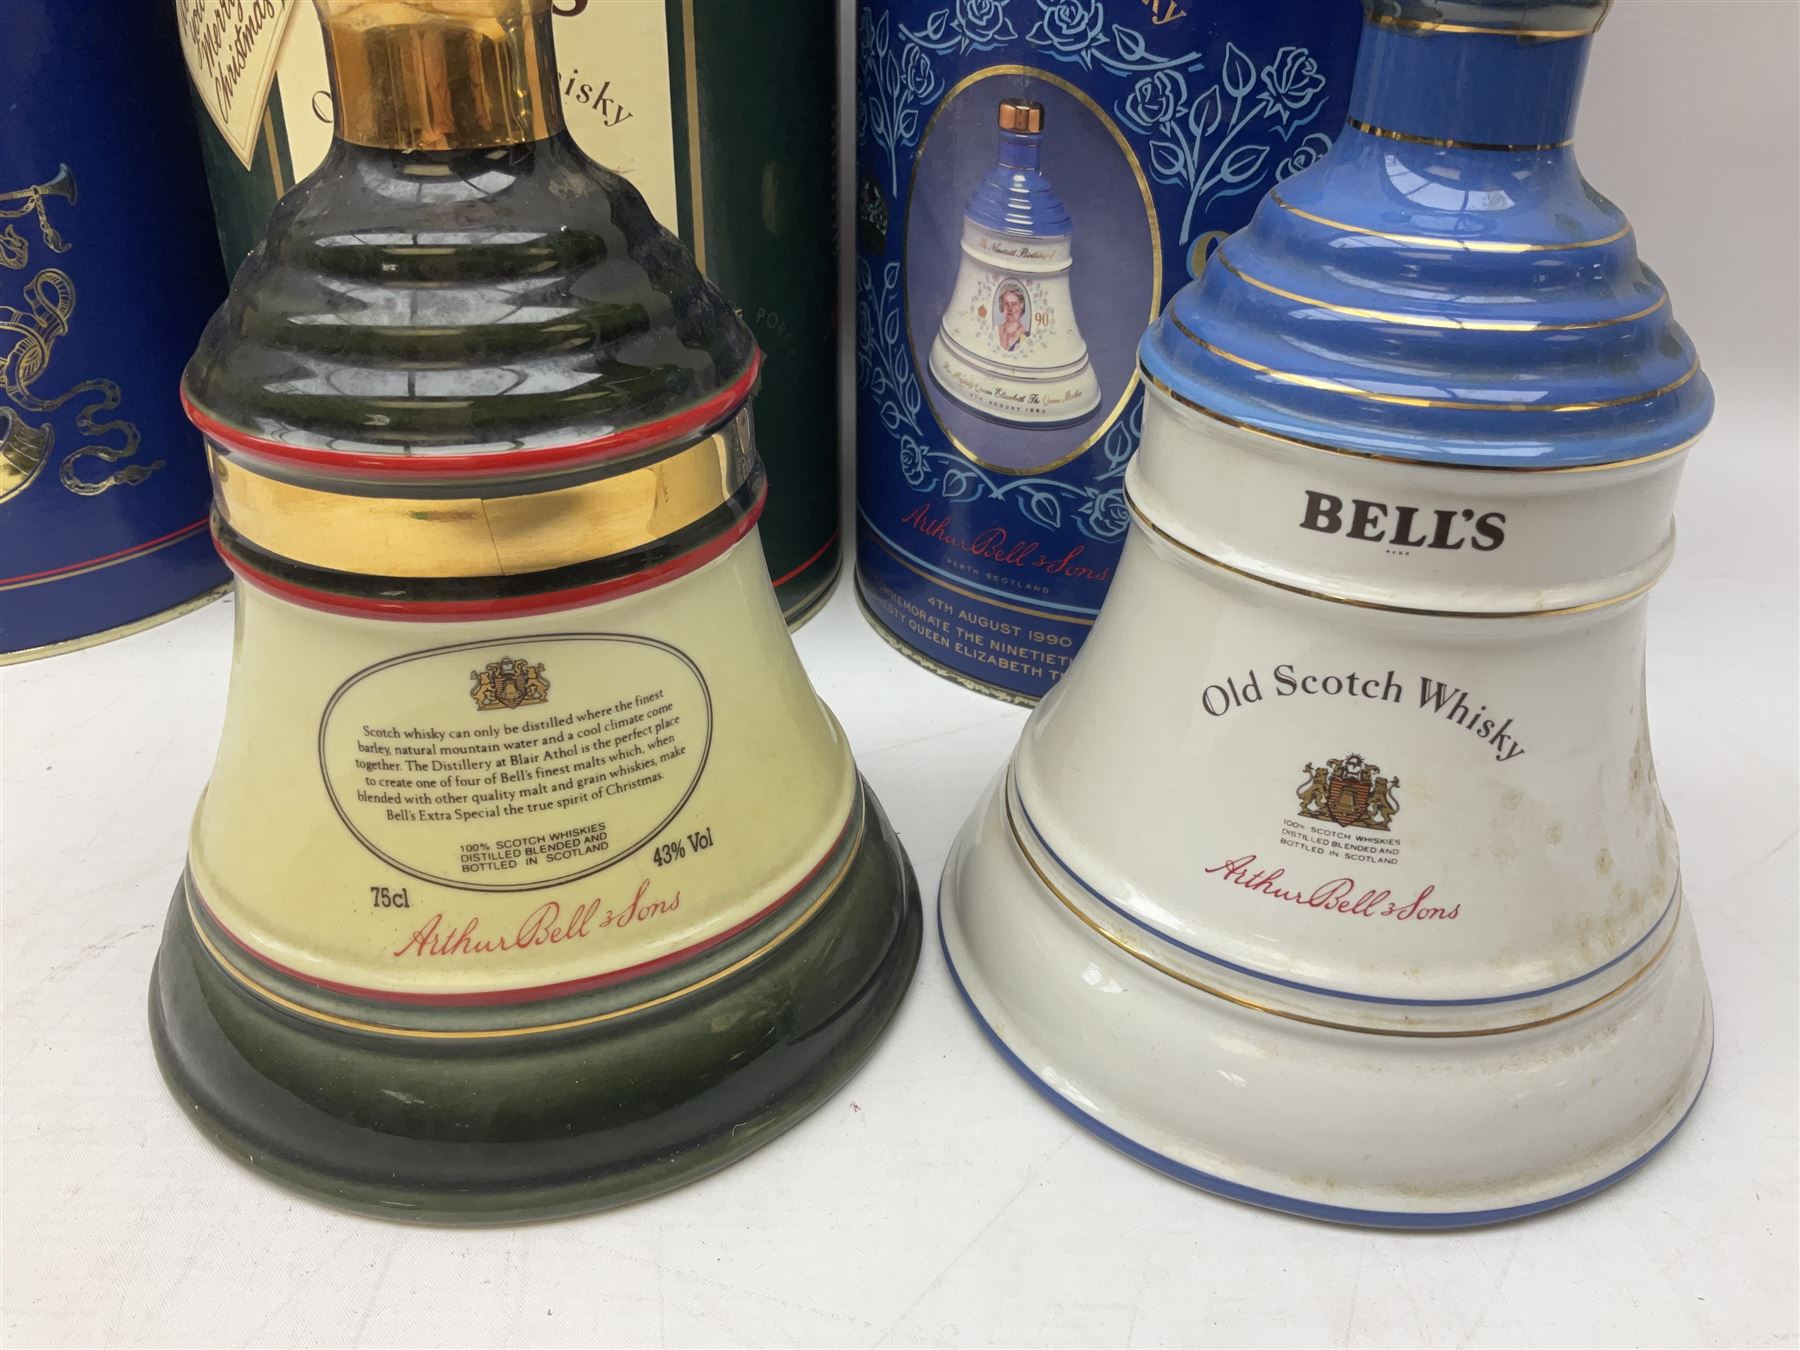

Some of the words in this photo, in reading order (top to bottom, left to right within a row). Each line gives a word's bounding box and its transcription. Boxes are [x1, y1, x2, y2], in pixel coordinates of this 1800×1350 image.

[558, 68, 633, 127] isky
[1034, 312, 1049, 327] 90
[901, 503, 972, 550] Arthur
[972, 527, 1040, 567] Bell
[1047, 545, 1111, 581] Sons
[1299, 490, 1506, 551] BELL'S
[946, 557, 980, 576] PERTH
[986, 571, 1050, 595] SCOTLAND
[928, 597, 953, 615] 4TH
[958, 609, 1022, 638] AUGUST
[1028, 630, 1072, 648] 1990
[956, 627, 985, 646] THE
[989, 639, 1075, 667] NINETIET
[908, 619, 950, 648] QUEEN
[954, 643, 1043, 678] ELIZABETH
[363, 725, 401, 739] Scotch
[404, 727, 445, 741] whisky
[449, 729, 470, 739] can
[473, 725, 500, 738] only
[503, 723, 519, 735] be
[522, 714, 574, 732] distilled
[576, 707, 613, 723] where
[615, 700, 633, 713] the
[635, 689, 664, 707] finest
[395, 744, 437, 756] natural
[440, 743, 501, 755] mountain
[503, 738, 539, 751] water
[542, 731, 565, 745] and
[568, 733, 574, 741] a
[577, 723, 602, 739] cool
[604, 713, 644, 732] climate
[647, 702, 673, 719] come
[1202, 669, 1263, 717] Old
[1273, 664, 1403, 703] Scotch
[1418, 676, 1526, 762] Whisky
[365, 776, 376, 786] to
[379, 778, 413, 788] create
[416, 780, 437, 788] one
[440, 775, 453, 788] of
[455, 775, 481, 787] four
[484, 772, 497, 785] of
[501, 770, 533, 784] Bell's
[536, 764, 571, 779] finest
[573, 755, 607, 772] malts
[609, 745, 645, 763] which,
[647, 734, 675, 750] when
[404, 759, 429, 771] The
[432, 758, 492, 772] Distillery
[496, 757, 507, 767] at
[510, 753, 539, 766] Blair
[543, 744, 578, 761] Athol
[582, 744, 590, 753] is
[593, 738, 612, 750] the
[615, 725, 653, 747] perfect
[655, 715, 680, 733] place
[357, 789, 401, 805] blended
[404, 793, 432, 805] with
[435, 792, 468, 804] other
[471, 789, 516, 806] quality
[519, 783, 548, 798] malt
[551, 777, 574, 793] and
[577, 772, 607, 790] grain
[609, 759, 658, 778] whiskies,
[660, 745, 687, 763] make
[386, 809, 416, 821] Bell's
[419, 810, 452, 821] Extra
[454, 806, 500, 822] Special
[503, 805, 524, 816] the
[527, 800, 554, 813] true
[556, 793, 589, 809] spirit
[591, 787, 604, 800] of
[605, 771, 664, 796] Christmas.
[460, 842, 490, 853] 100%
[496, 834, 546, 850] SCOTCH
[549, 822, 607, 841] WHISKIES
[460, 850, 522, 864] DISTILLED
[525, 838, 581, 856] BLENDED
[583, 831, 608, 843] AND
[461, 859, 517, 873] BOTTLED
[525, 856, 538, 866] IN
[546, 841, 609, 862] SCOTLAND
[653, 838, 686, 868] 43%
[687, 827, 714, 853] Vol
[1280, 837, 1325, 855] BOTTLED
[1329, 850, 1339, 858] IN
[1344, 852, 1398, 865] SCOTLAND
[1281, 828, 1329, 846] DISTILLED
[1331, 840, 1377, 853] BLENDED
[1379, 847, 1399, 856] AND
[1310, 826, 1351, 840] SCOTCH
[1355, 835, 1401, 846] WHISKIES
[370, 886, 410, 909] 75cl
[1204, 855, 1308, 905] Arthur
[1309, 878, 1391, 918] Bell
[1396, 885, 1461, 921] Sons
[393, 914, 512, 958] Arthur
[514, 898, 601, 949] Bell
[616, 878, 680, 928] Sons
